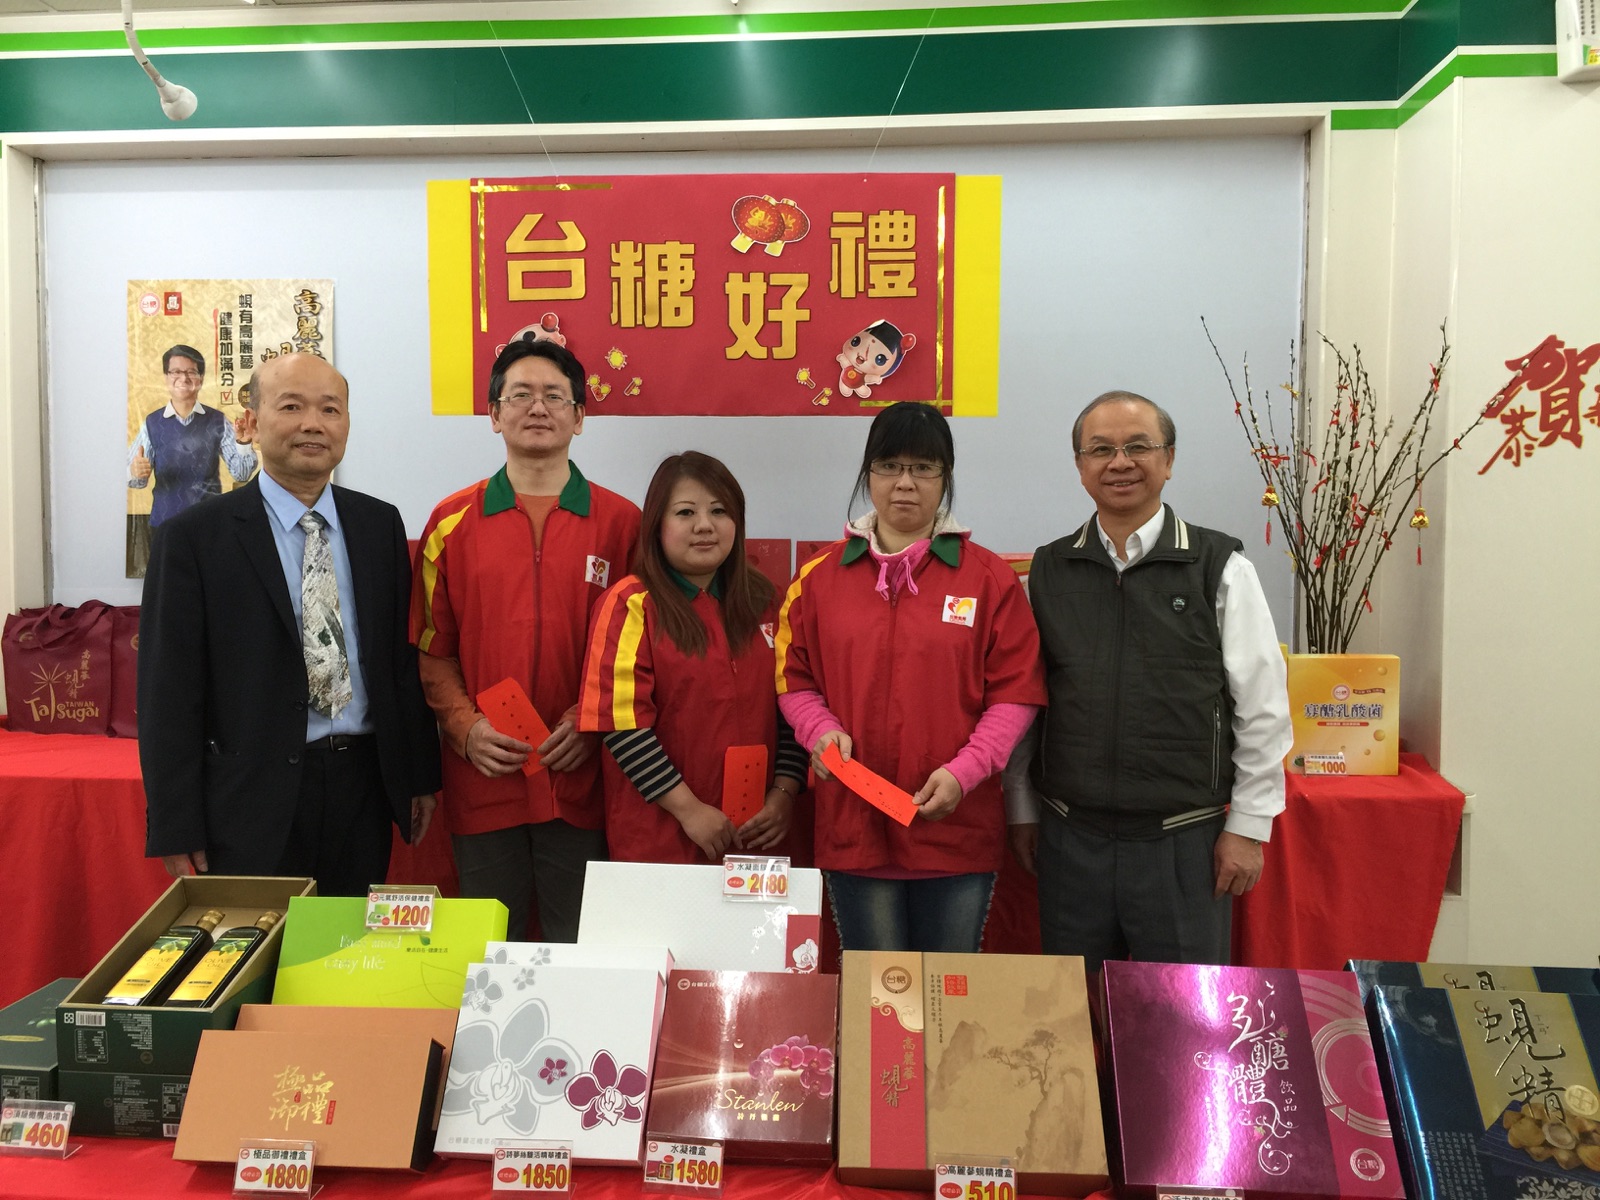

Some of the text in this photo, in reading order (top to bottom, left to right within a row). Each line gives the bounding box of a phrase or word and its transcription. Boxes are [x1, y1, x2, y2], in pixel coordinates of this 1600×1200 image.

[506, 210, 917, 360] 台糖好禮
[219, 312, 234, 386] 健康加滿分
[1322, 761, 1346, 773] 1000
[379, 894, 431, 903] 元氣舒活保健禮盒
[392, 905, 430, 926] 1200
[886, 975, 907, 984] 台糖
[718, 1089, 804, 1113] Stanlen
[1279, 1079, 1298, 1113] 飲品
[25, 1122, 65, 1148] 460
[253, 1149, 307, 1161] 極品御禮禮盒
[671, 1144, 707, 1156] 水凝禮盒
[677, 1159, 719, 1185] 1580
[1357, 1158, 1379, 1171] 台糖
[266, 1164, 308, 1190] 1880
[523, 1163, 567, 1189] 1850
[969, 1180, 1013, 1200] 510
